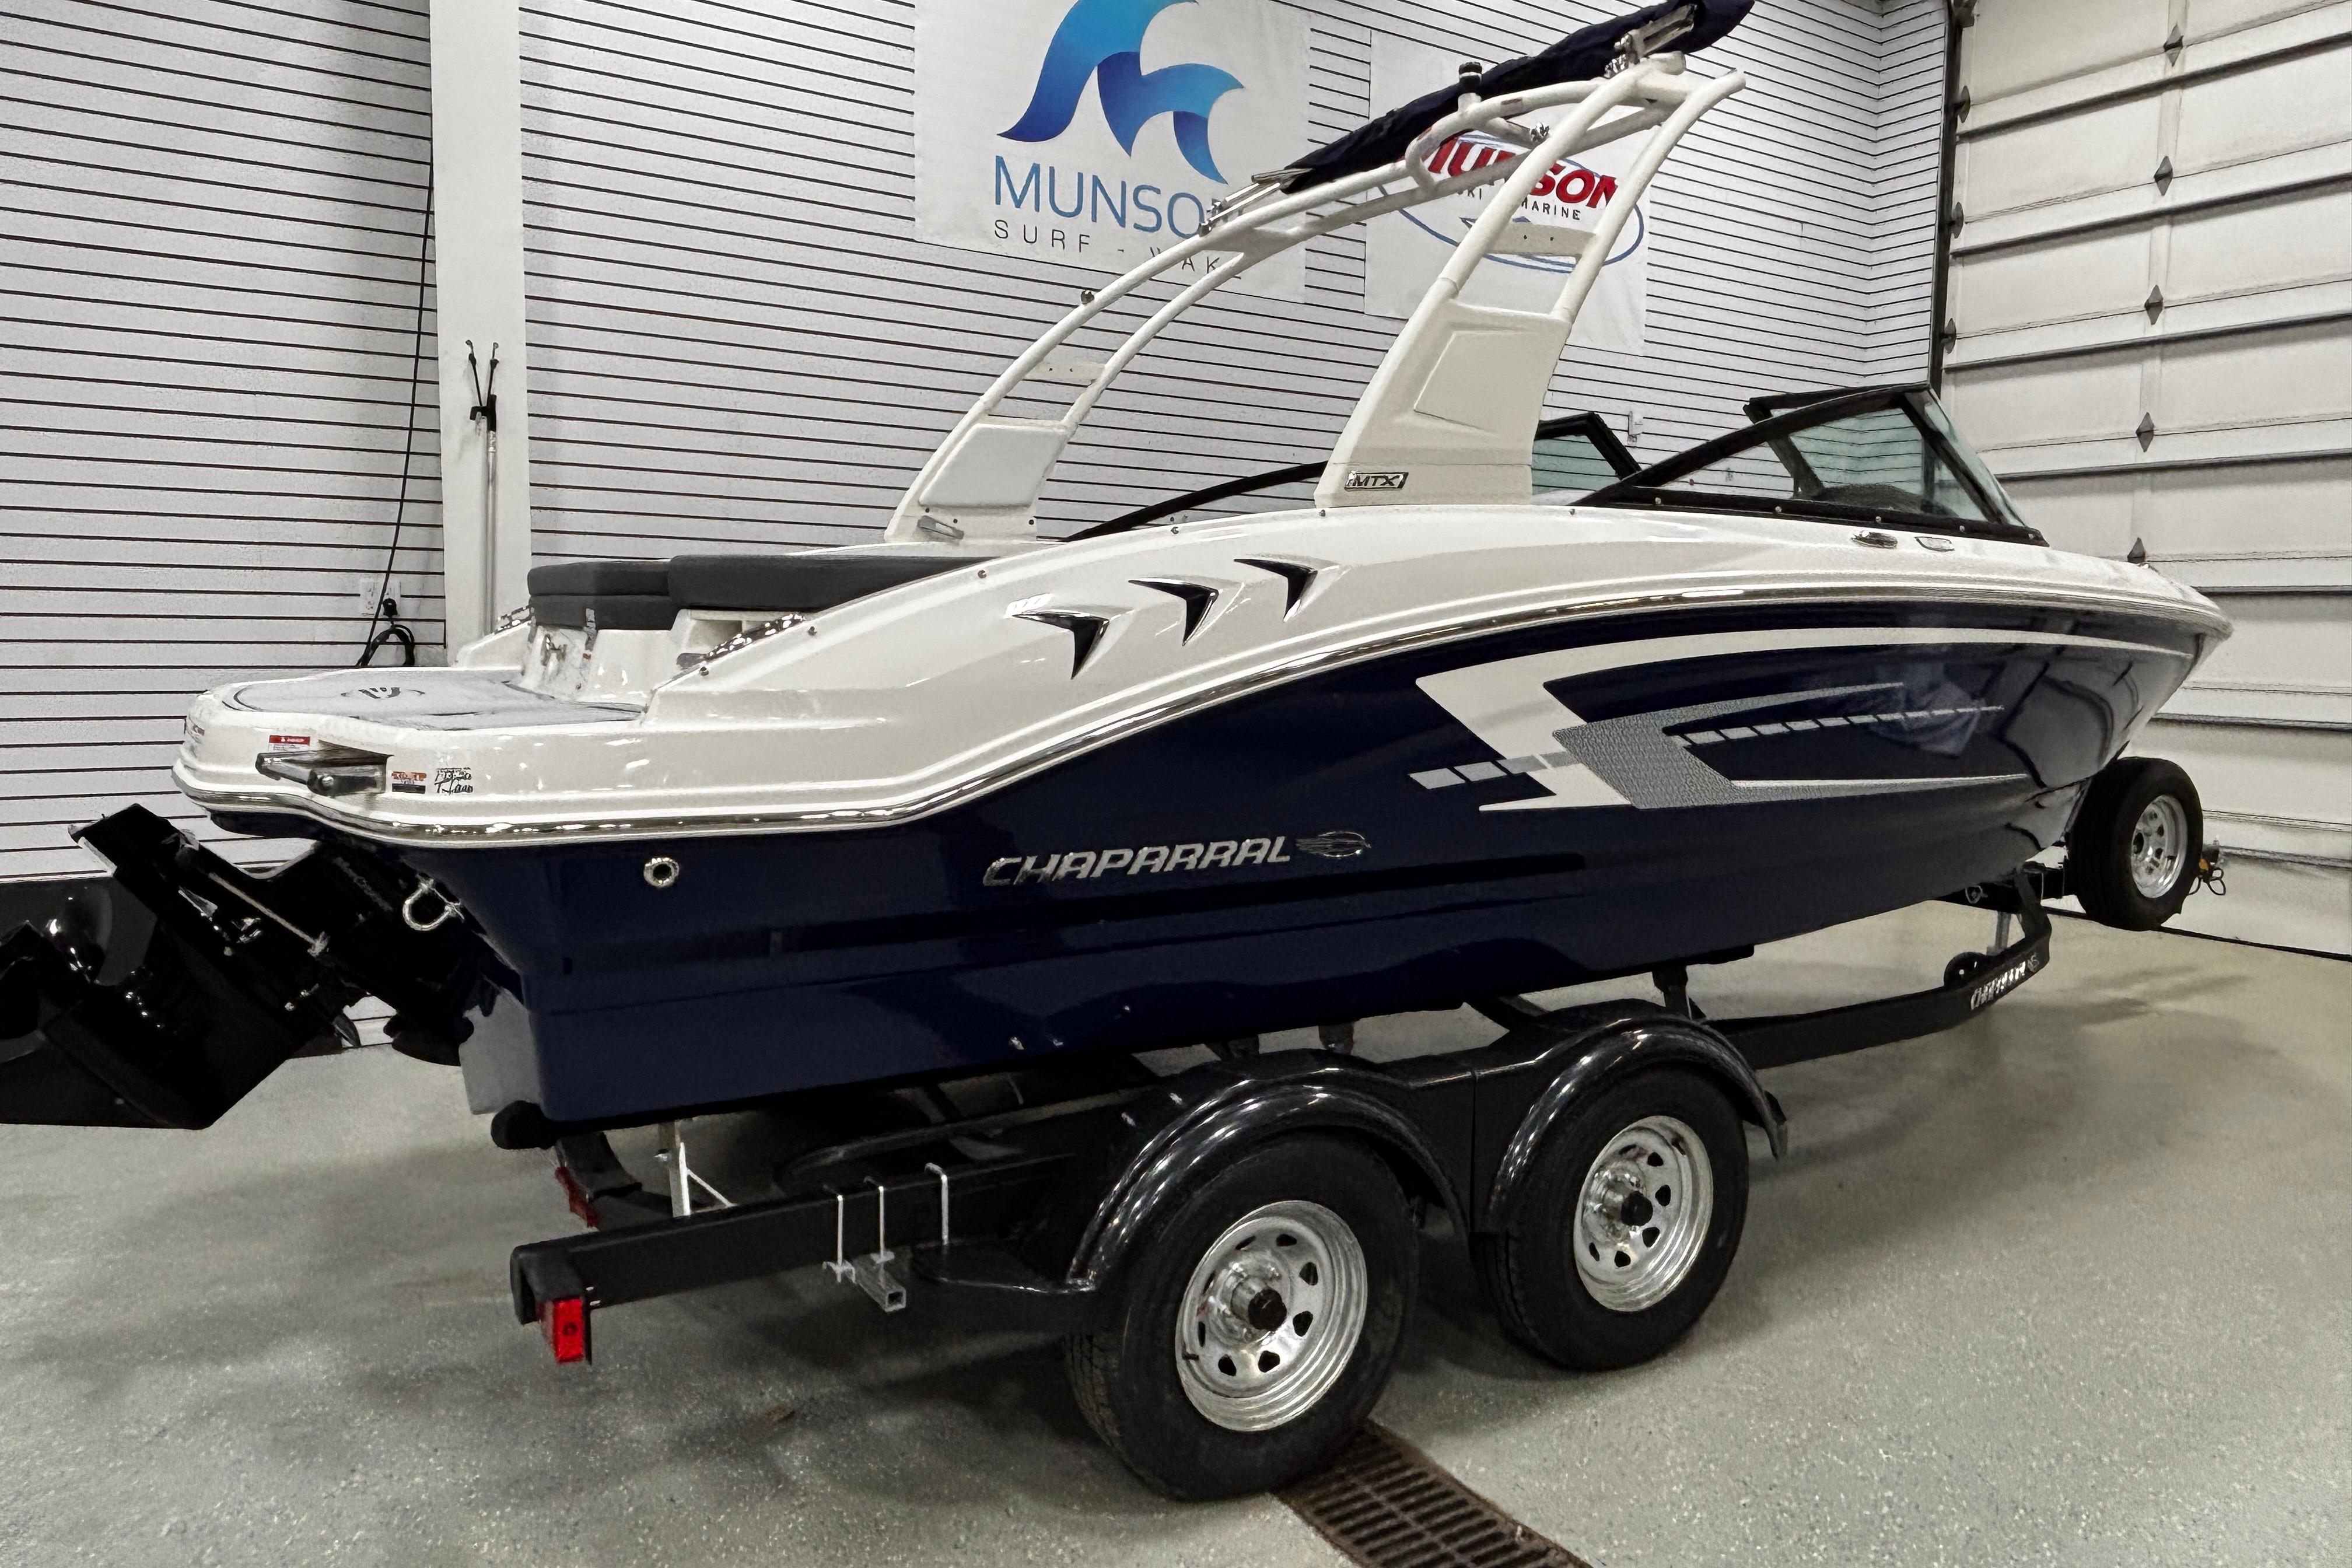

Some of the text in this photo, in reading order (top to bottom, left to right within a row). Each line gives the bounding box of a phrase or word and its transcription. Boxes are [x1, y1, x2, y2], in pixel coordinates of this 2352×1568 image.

[995, 155, 1241, 240] MUNSO
[994, 219, 1090, 253] SURF
[1351, 475, 1401, 487] MTX
[982, 836, 1290, 886] CHAPARRAL
